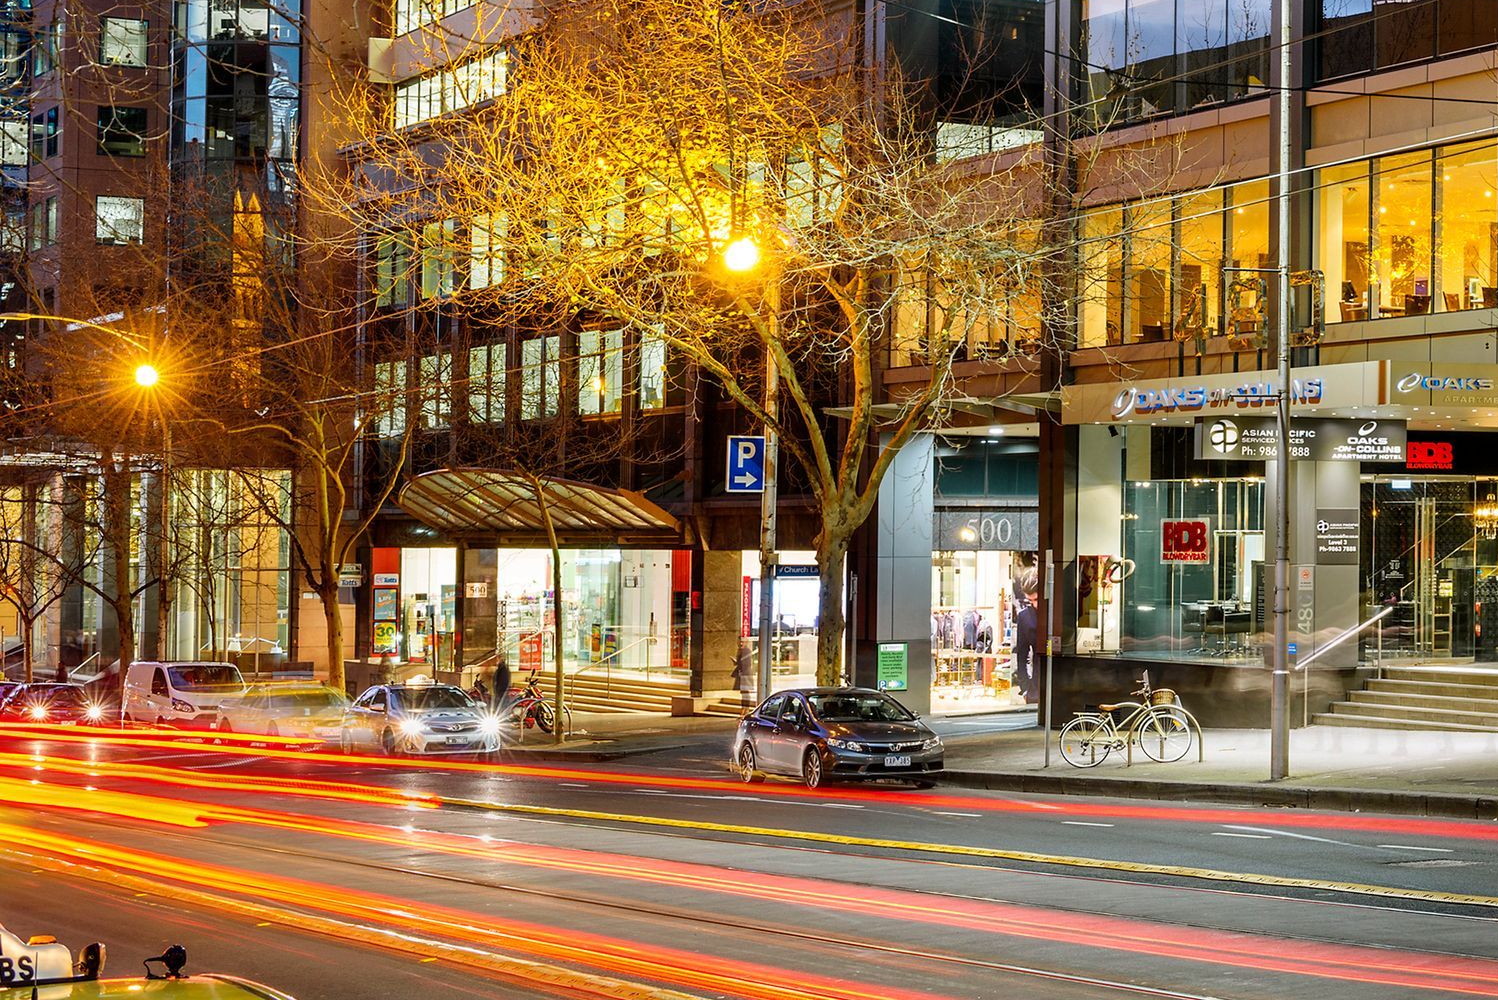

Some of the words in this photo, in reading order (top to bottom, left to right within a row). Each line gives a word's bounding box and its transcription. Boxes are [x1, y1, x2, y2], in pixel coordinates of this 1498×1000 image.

[1422, 375, 1494, 391] OAKS
[1135, 386, 1206, 413] OAKS
[1242, 429, 1274, 437] ASIAN
[1347, 437, 1388, 445] OAKS
[737, 441, 756, 468] P
[1241, 446, 1256, 456] Ph:
[1259, 446, 1278, 456] 986
[1356, 445, 1401, 454] COLLINS
[1406, 441, 1453, 463] BDB
[966, 518, 1013, 544] 500
[1163, 521, 1207, 552] BDB
